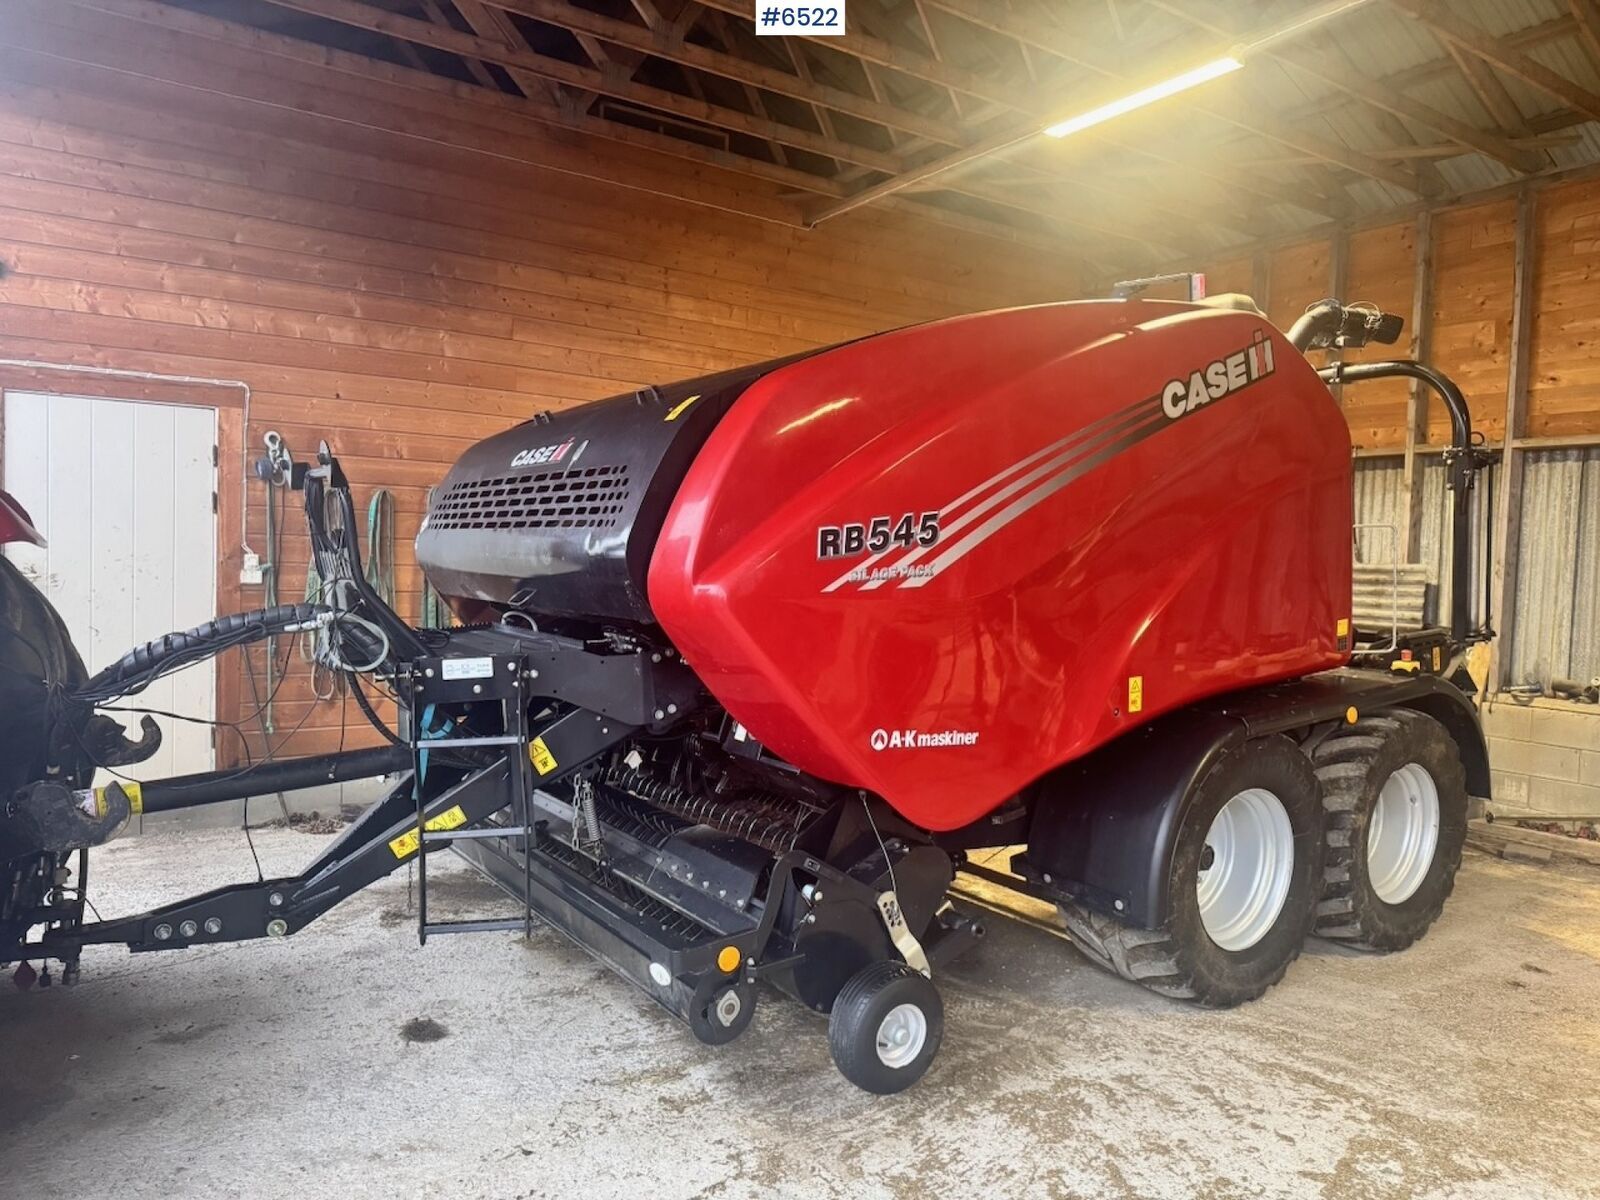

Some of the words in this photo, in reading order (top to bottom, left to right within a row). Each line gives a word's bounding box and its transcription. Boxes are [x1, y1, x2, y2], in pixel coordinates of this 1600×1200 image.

[817, 510, 940, 560] RB545
[898, 562, 935, 578] PACK
[917, 730, 979, 747] maskiner
